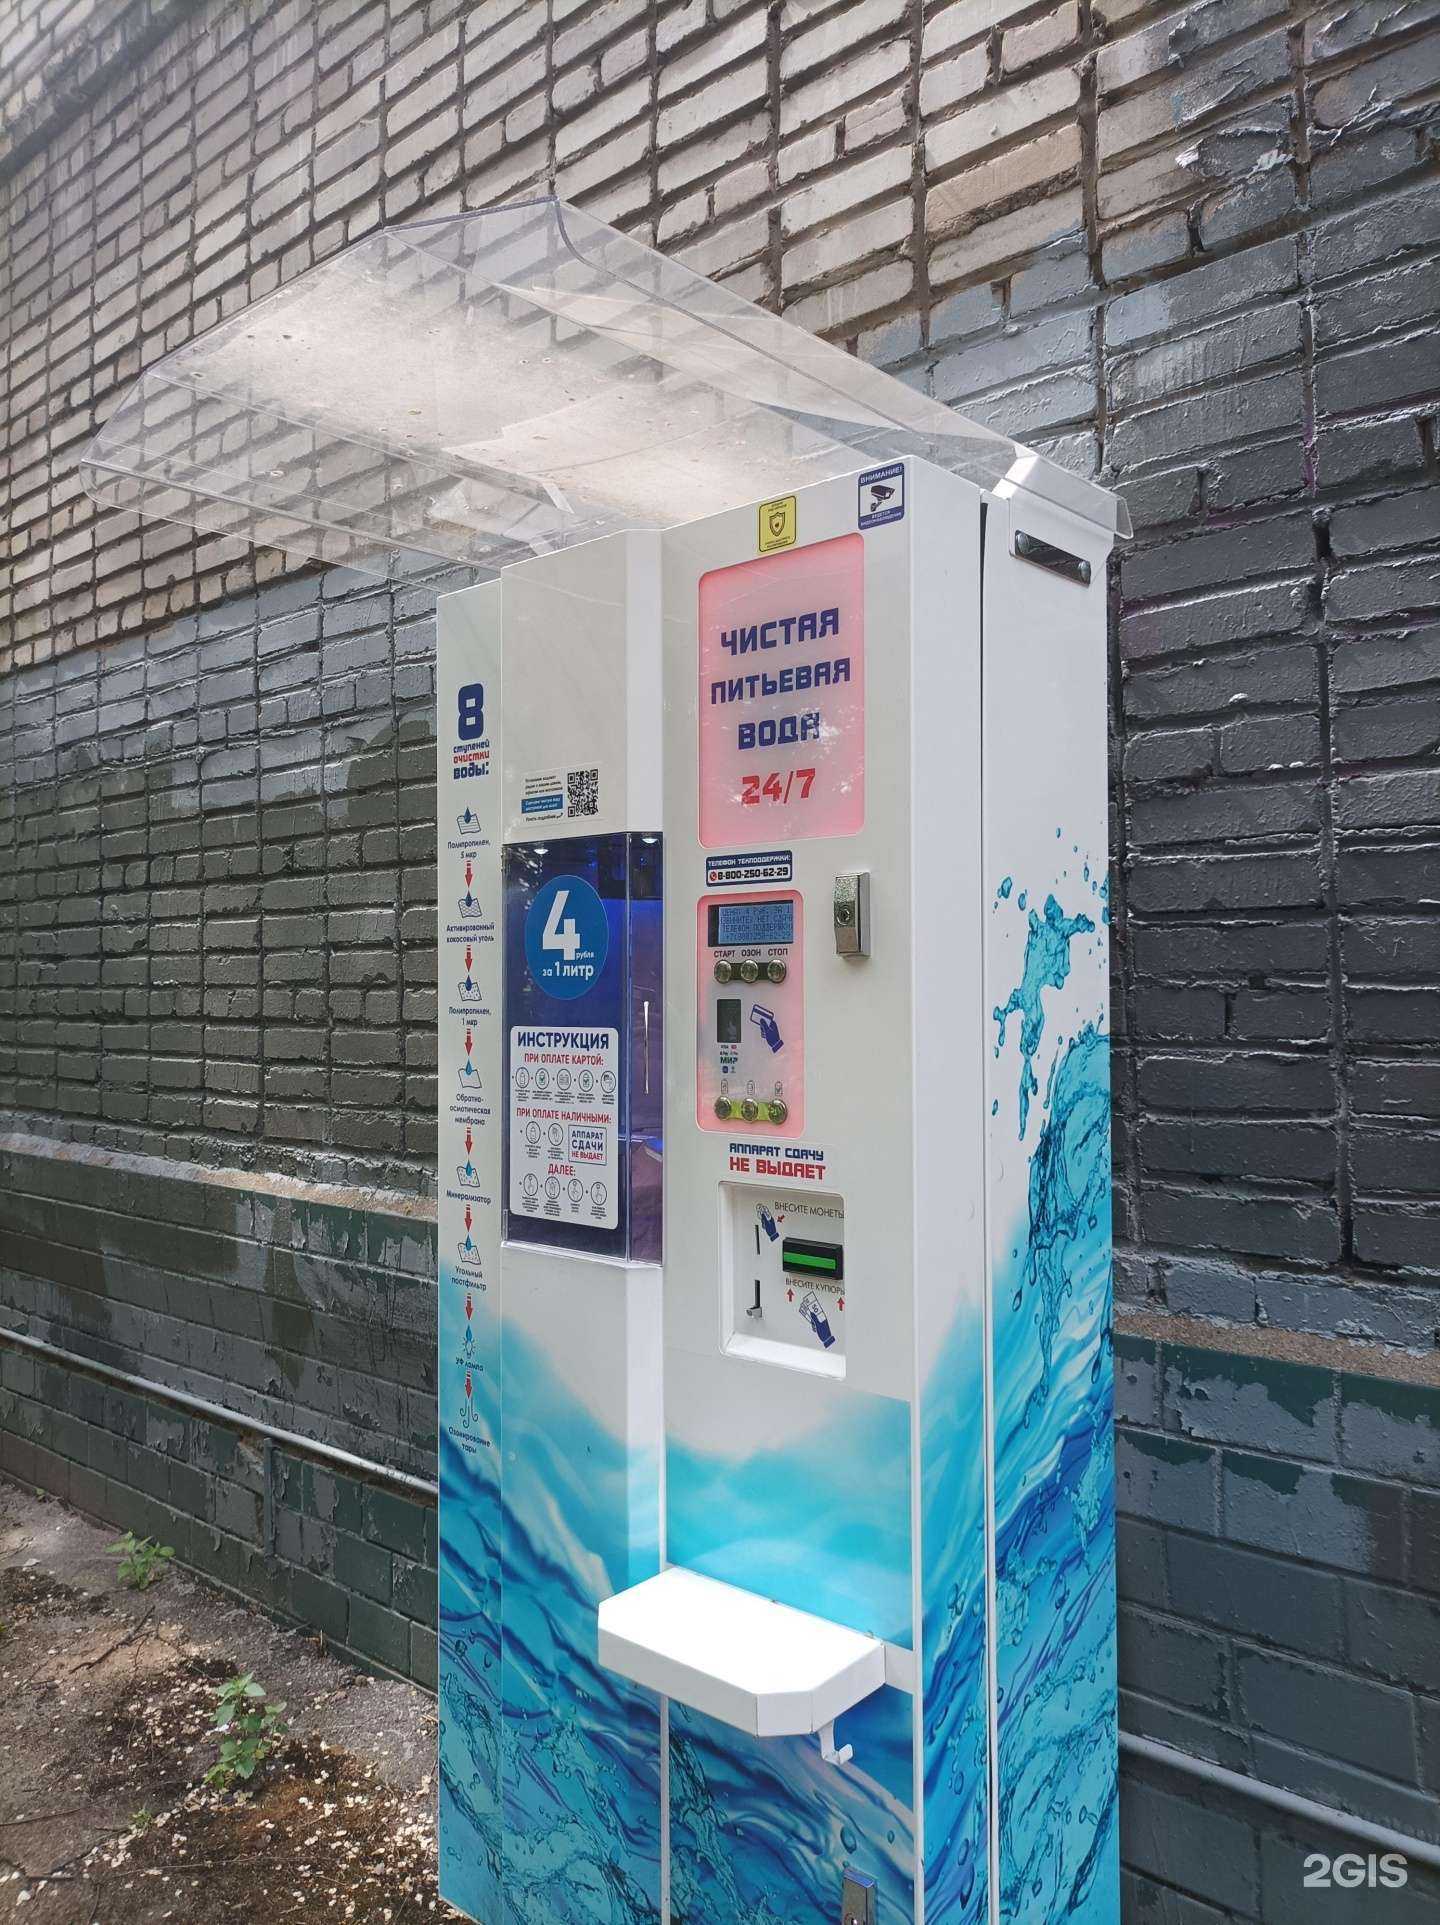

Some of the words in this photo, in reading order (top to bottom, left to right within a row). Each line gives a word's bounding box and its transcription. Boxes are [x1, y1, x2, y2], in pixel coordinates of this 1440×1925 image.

[860, 466, 902, 483] ВНИМАНИЕ!
[721, 607, 839, 655] ЧИСТАЯ
[711, 657, 850, 704] ПИТЬЕВАЯ
[458, 683, 484, 741] 8
[738, 712, 820, 750] ВОДА
[453, 739, 490, 755] ступеней
[453, 750, 490, 764] очистки
[453, 761, 490, 780] воды:
[741, 768, 815, 805] 24/7
[708, 859, 736, 867] ТЕЛЕФОН
[446, 922, 495, 933] Активированный
[542, 890, 581, 961] 4
[446, 934, 478, 944] кокосовый
[478, 934, 494, 944] уголь
[576, 951, 594, 960] рубля
[713, 950, 735, 958] СТАРТ
[741, 948, 761, 957] ОЗОН
[768, 948, 788, 956] СТОП
[542, 969, 552, 977] за
[555, 961, 560, 976] 1
[563, 964, 594, 981] литр
[517, 1031, 609, 1051] ИНСТРУКЦИЯ
[524, 1053, 539, 1063] ПРИ
[541, 1053, 570, 1065] ОПЛАТЕ
[572, 1053, 604, 1066] КАРТОЙ:
[449, 1105, 491, 1115] осмотическая
[516, 1107, 531, 1117] ПРИ
[532, 1109, 559, 1120] ОПЛАТЕ
[561, 1111, 611, 1124] НАЛИЧНЫМИ:
[454, 1116, 485, 1126] мембрана
[571, 1130, 603, 1140] АППАРАТ
[571, 1139, 603, 1151] СДАЧИ
[729, 1142, 781, 1157] АППАРАТ
[785, 1147, 824, 1161] СДАЧУ
[580, 1151, 603, 1161] ВЫДАЕТ
[548, 1163, 576, 1176] ДАЛЕЕ:
[729, 1156, 750, 1172] НЕ
[756, 1159, 826, 1180] ВЫДАЕТ
[446, 1189, 491, 1205] Минерализатор
[774, 1201, 808, 1215] ВНЕСИТЕ
[809, 1207, 844, 1219] МОНЕТЫ
[455, 1265, 482, 1279] Угольный
[451, 1277, 486, 1291] постфильтр
[785, 1278, 814, 1290] ВНЕСИТЕ
